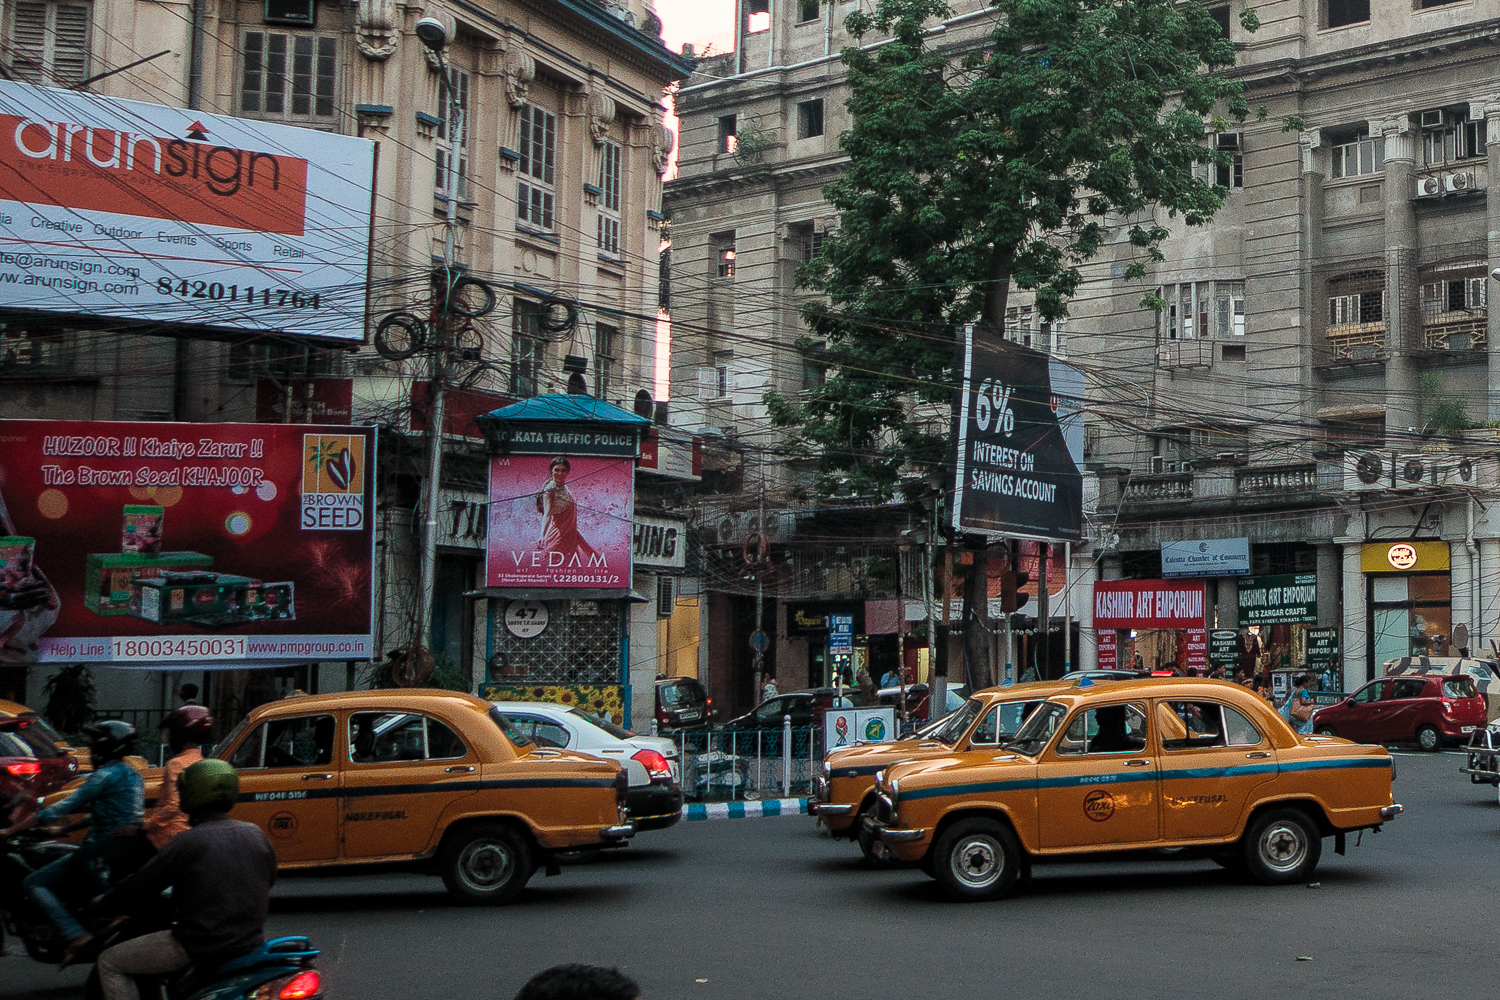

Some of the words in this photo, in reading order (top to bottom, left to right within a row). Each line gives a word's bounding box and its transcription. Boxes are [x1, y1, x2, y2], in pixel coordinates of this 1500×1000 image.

[14, 119, 280, 197] arunsign
[31, 216, 84, 234] Creative
[93, 222, 144, 240] Outdoor
[157, 231, 198, 247] Events
[215, 236, 252, 253] Sports
[273, 244, 305, 260] Retail
[156, 276, 321, 310] 8420111764
[43, 435, 121, 457] HUZOOR
[140, 437, 195, 460] Khaiye
[197, 439, 249, 458] Zarur
[546, 432, 591, 445] TRAFFIC
[594, 433, 633, 446] POLICE
[972, 440, 1019, 470] INTEREST
[1019, 451, 1035, 473] ON
[41, 464, 76, 486] The
[77, 466, 132, 486] Brown
[135, 466, 180, 486] Seed
[181, 466, 265, 487] KHAJOOR
[970, 468, 1014, 496] SAVINGS
[1014, 477, 1057, 503] ACCOUNT
[308, 494, 363, 505] BROWN
[303, 507, 363, 528] SEED
[511, 550, 609, 568] VEDAM
[1165, 556, 1186, 564] Calcutta
[1188, 555, 1210, 563] Chamber
[1220, 553, 1247, 561] Commerce
[559, 574, 620, 584] 22800131/2
[1096, 591, 1134, 619] KASHMIR
[1136, 591, 1154, 619] ART
[1155, 590, 1203, 619] EMPORIUM
[1239, 588, 1267, 607] KASHMIR
[1268, 587, 1282, 606] ART
[1283, 585, 1316, 604] EMPORIUM
[515, 608, 539, 619] 47
[1260, 608, 1284, 617] ZARGAR
[1284, 607, 1308, 616] CRAFTS
[1102, 635, 1111, 643] ART
[1192, 634, 1201, 642] ART
[51, 643, 77, 657] Help
[79, 642, 105, 656] Line
[113, 639, 245, 657] 18003450031
[247, 641, 364, 656] www.pmpgroup.co.in
[1308, 647, 1338, 655] EMPORIM
